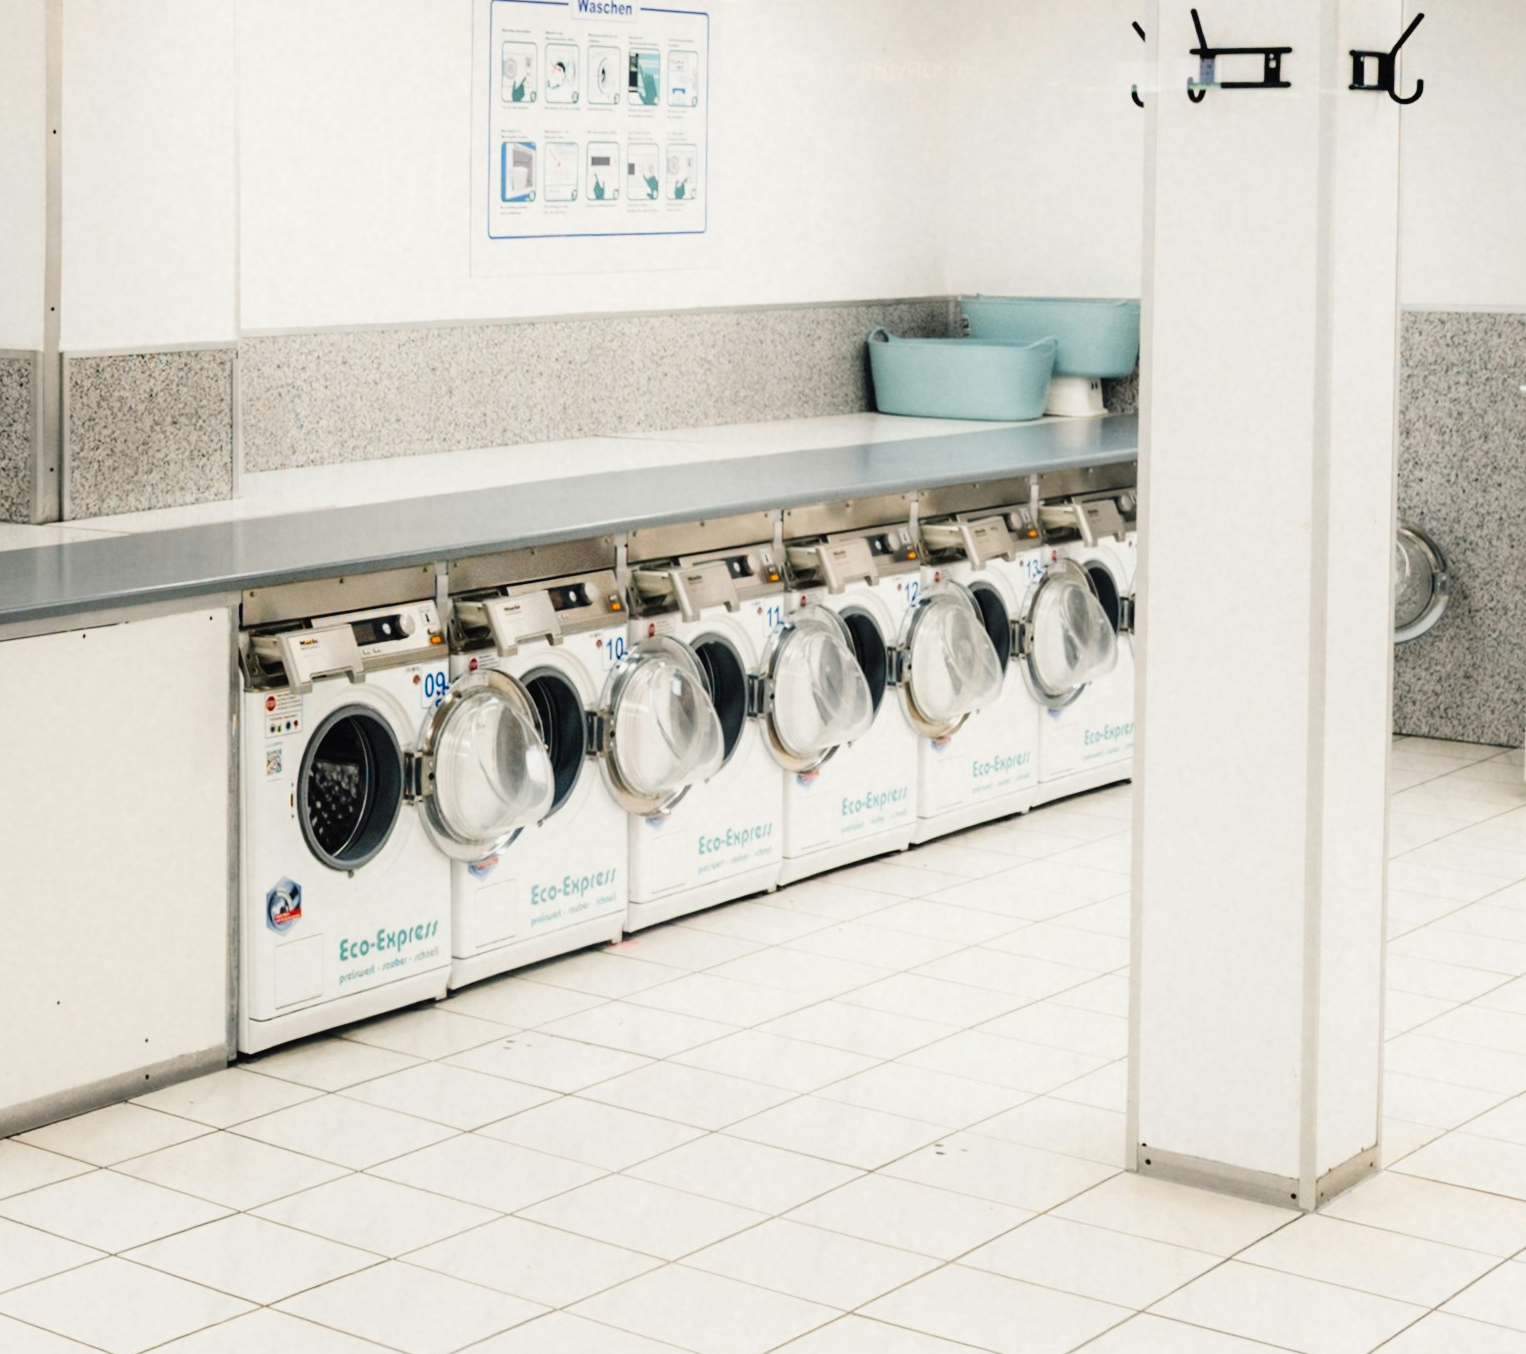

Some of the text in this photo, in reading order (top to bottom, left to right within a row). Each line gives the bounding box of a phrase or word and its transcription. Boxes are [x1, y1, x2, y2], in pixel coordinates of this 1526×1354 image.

[606, 637, 624, 660] 10
[425, 672, 446, 697] 09
[1083, 721, 1135, 746] Eco-Expres
[972, 750, 1031, 778] Eco-Express
[841, 786, 908, 816] Eco-Express
[698, 821, 773, 855] Eco-Express
[530, 867, 617, 906] Eco-Express
[339, 919, 438, 962] Eco-Express
